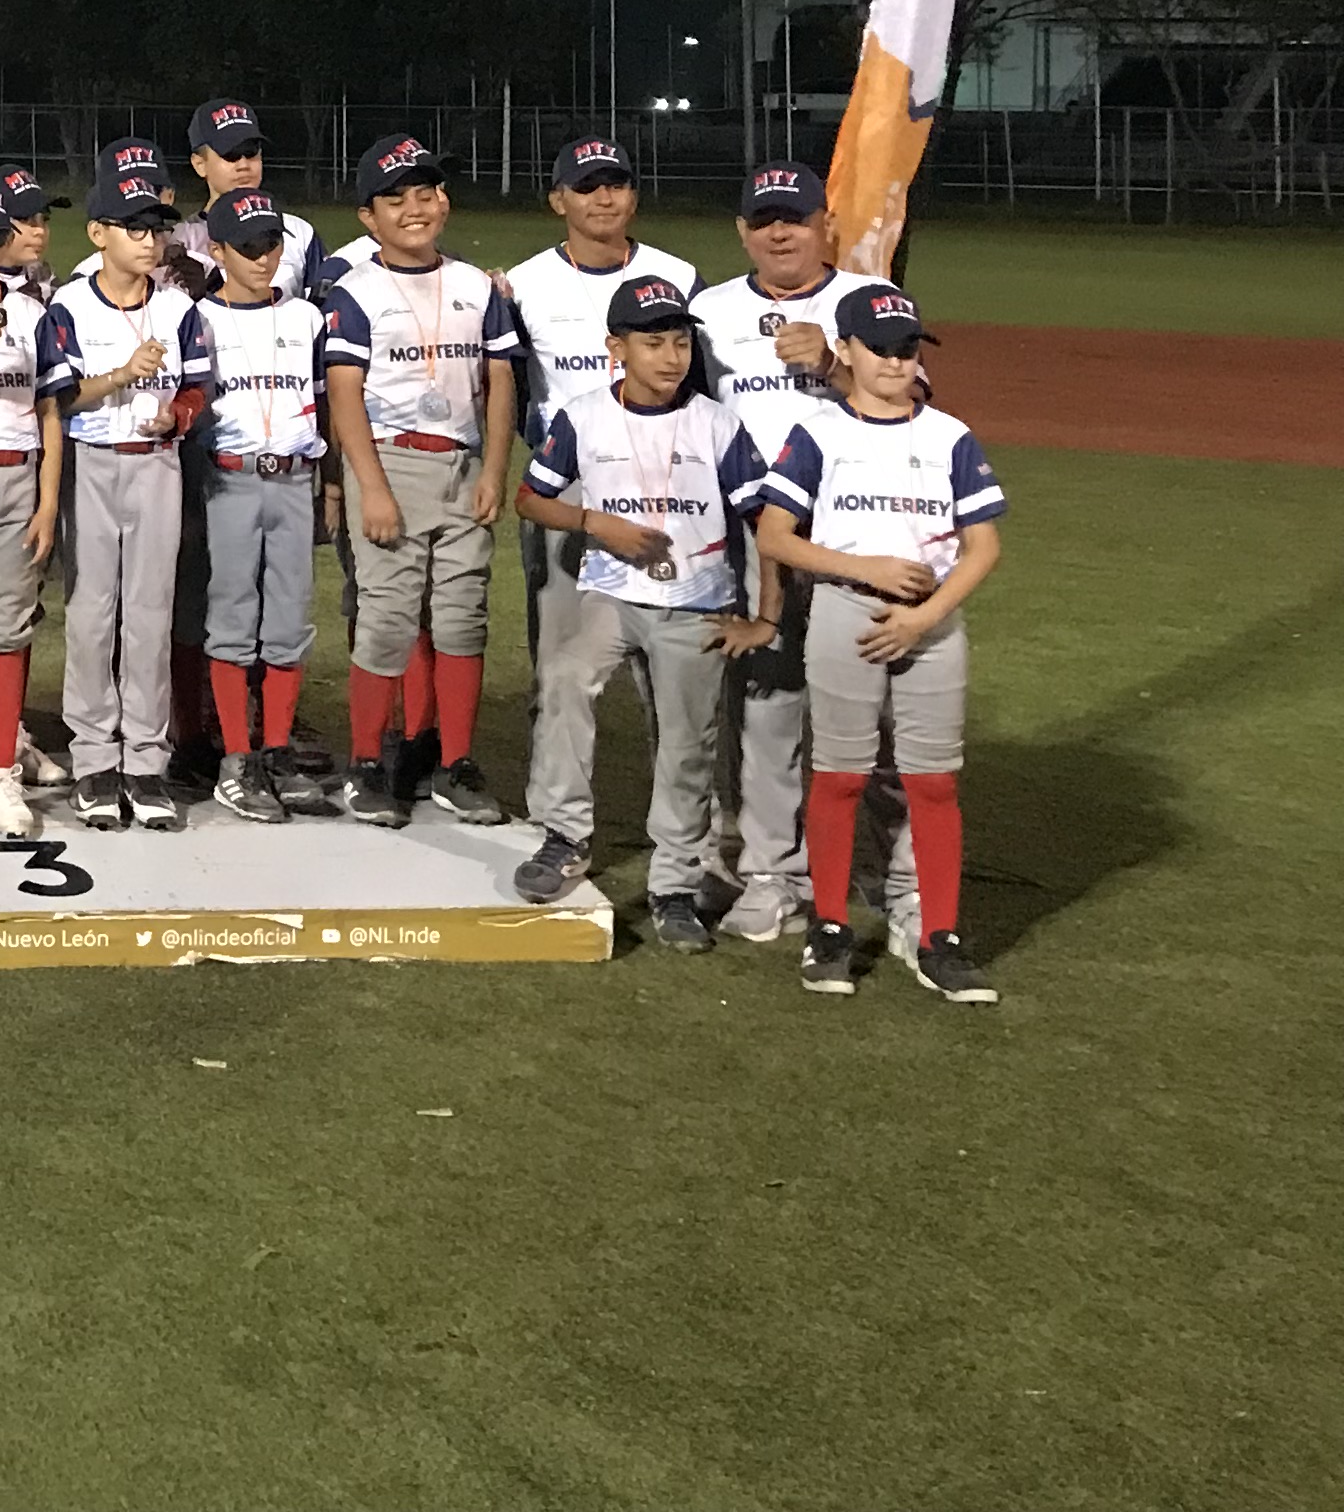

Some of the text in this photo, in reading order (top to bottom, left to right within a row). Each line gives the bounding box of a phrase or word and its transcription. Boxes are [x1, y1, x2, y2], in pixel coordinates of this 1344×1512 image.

[211, 103, 248, 124] MTY
[114, 146, 155, 166] MTY
[573, 141, 617, 160] MTY
[754, 169, 799, 190] MTY
[232, 193, 273, 217] MTY
[634, 284, 676, 303] MTY
[869, 295, 914, 313] MTY
[390, 343, 480, 363] MONTERRE
[554, 355, 627, 371] MONTE
[833, 494, 951, 517] MONTERREY
[61, 928, 109, 947] León
[161, 927, 297, 950] @nlindeoficial
[349, 926, 440, 948] @NL Inde
